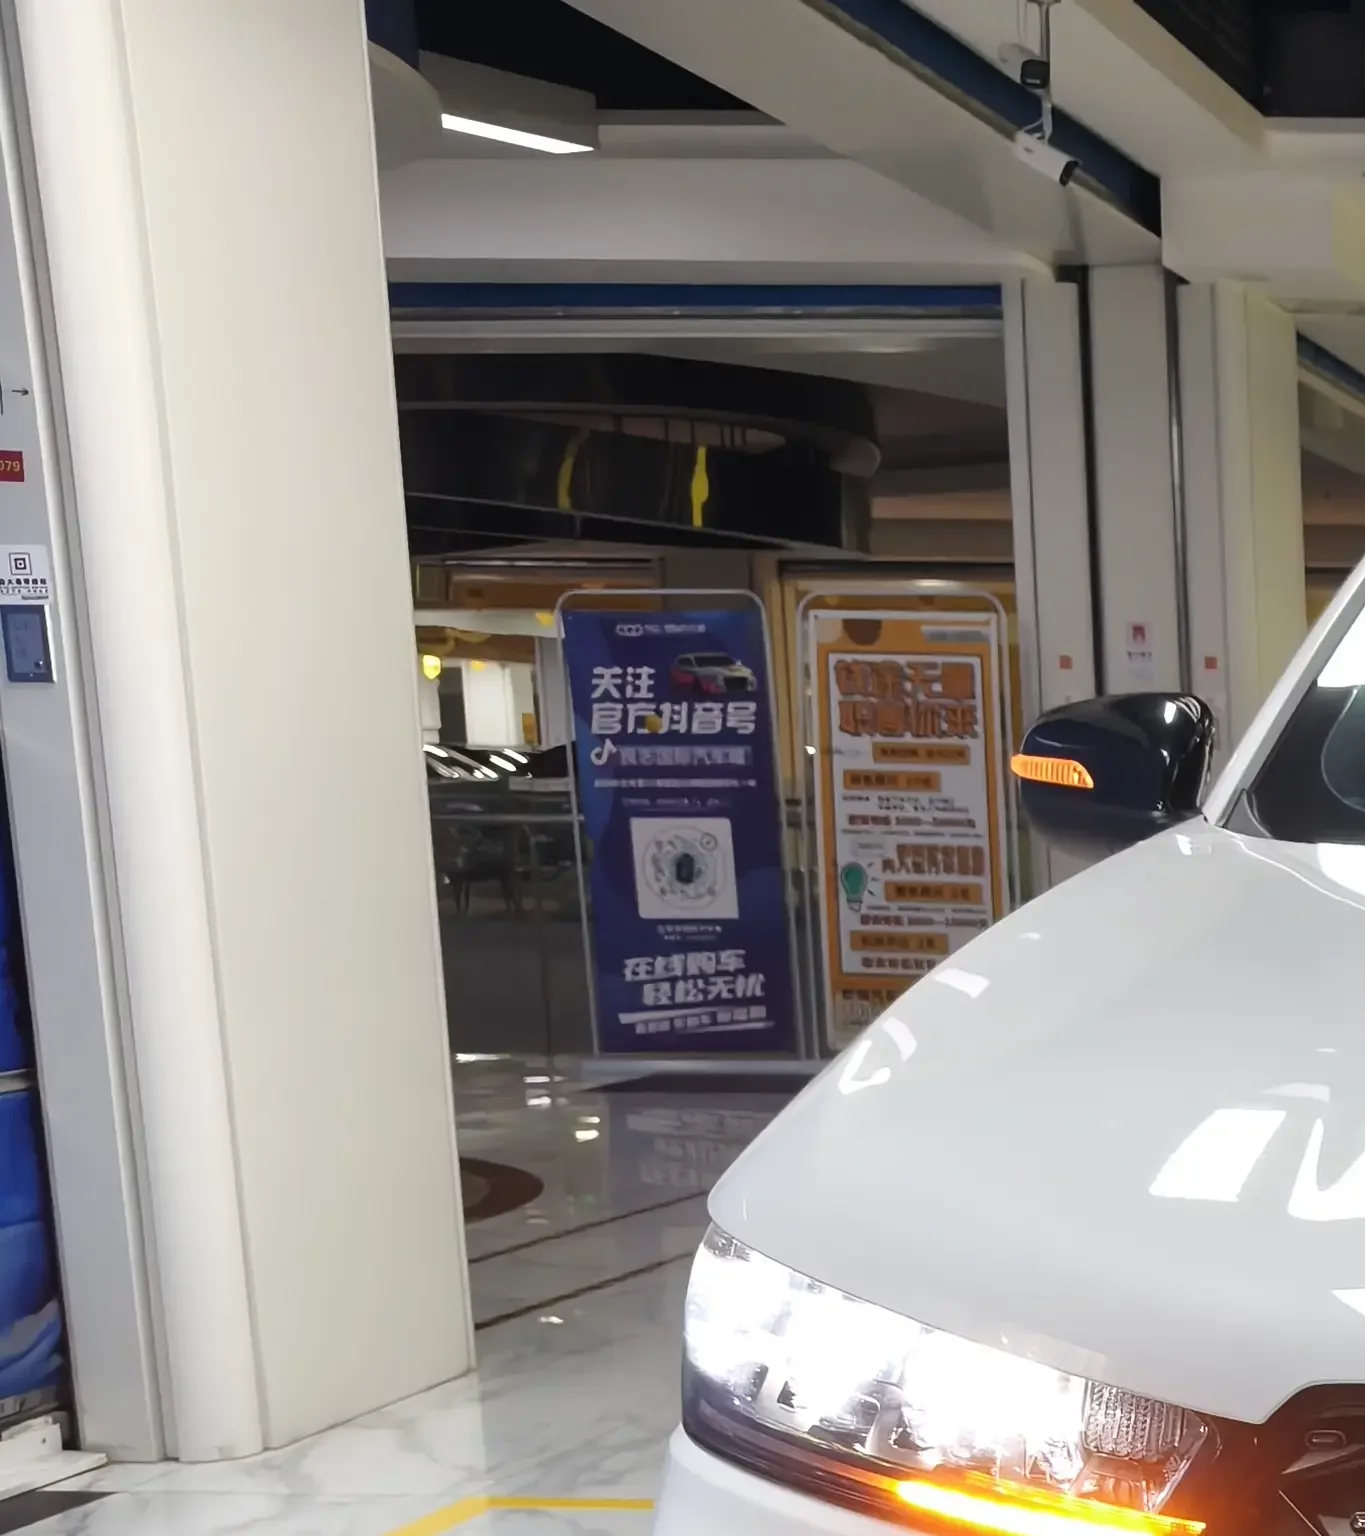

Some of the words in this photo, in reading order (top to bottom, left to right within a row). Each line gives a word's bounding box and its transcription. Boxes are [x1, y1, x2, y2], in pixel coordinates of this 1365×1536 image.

[590, 665, 656, 699] 关注
[590, 701, 757, 735] 官方抖音号
